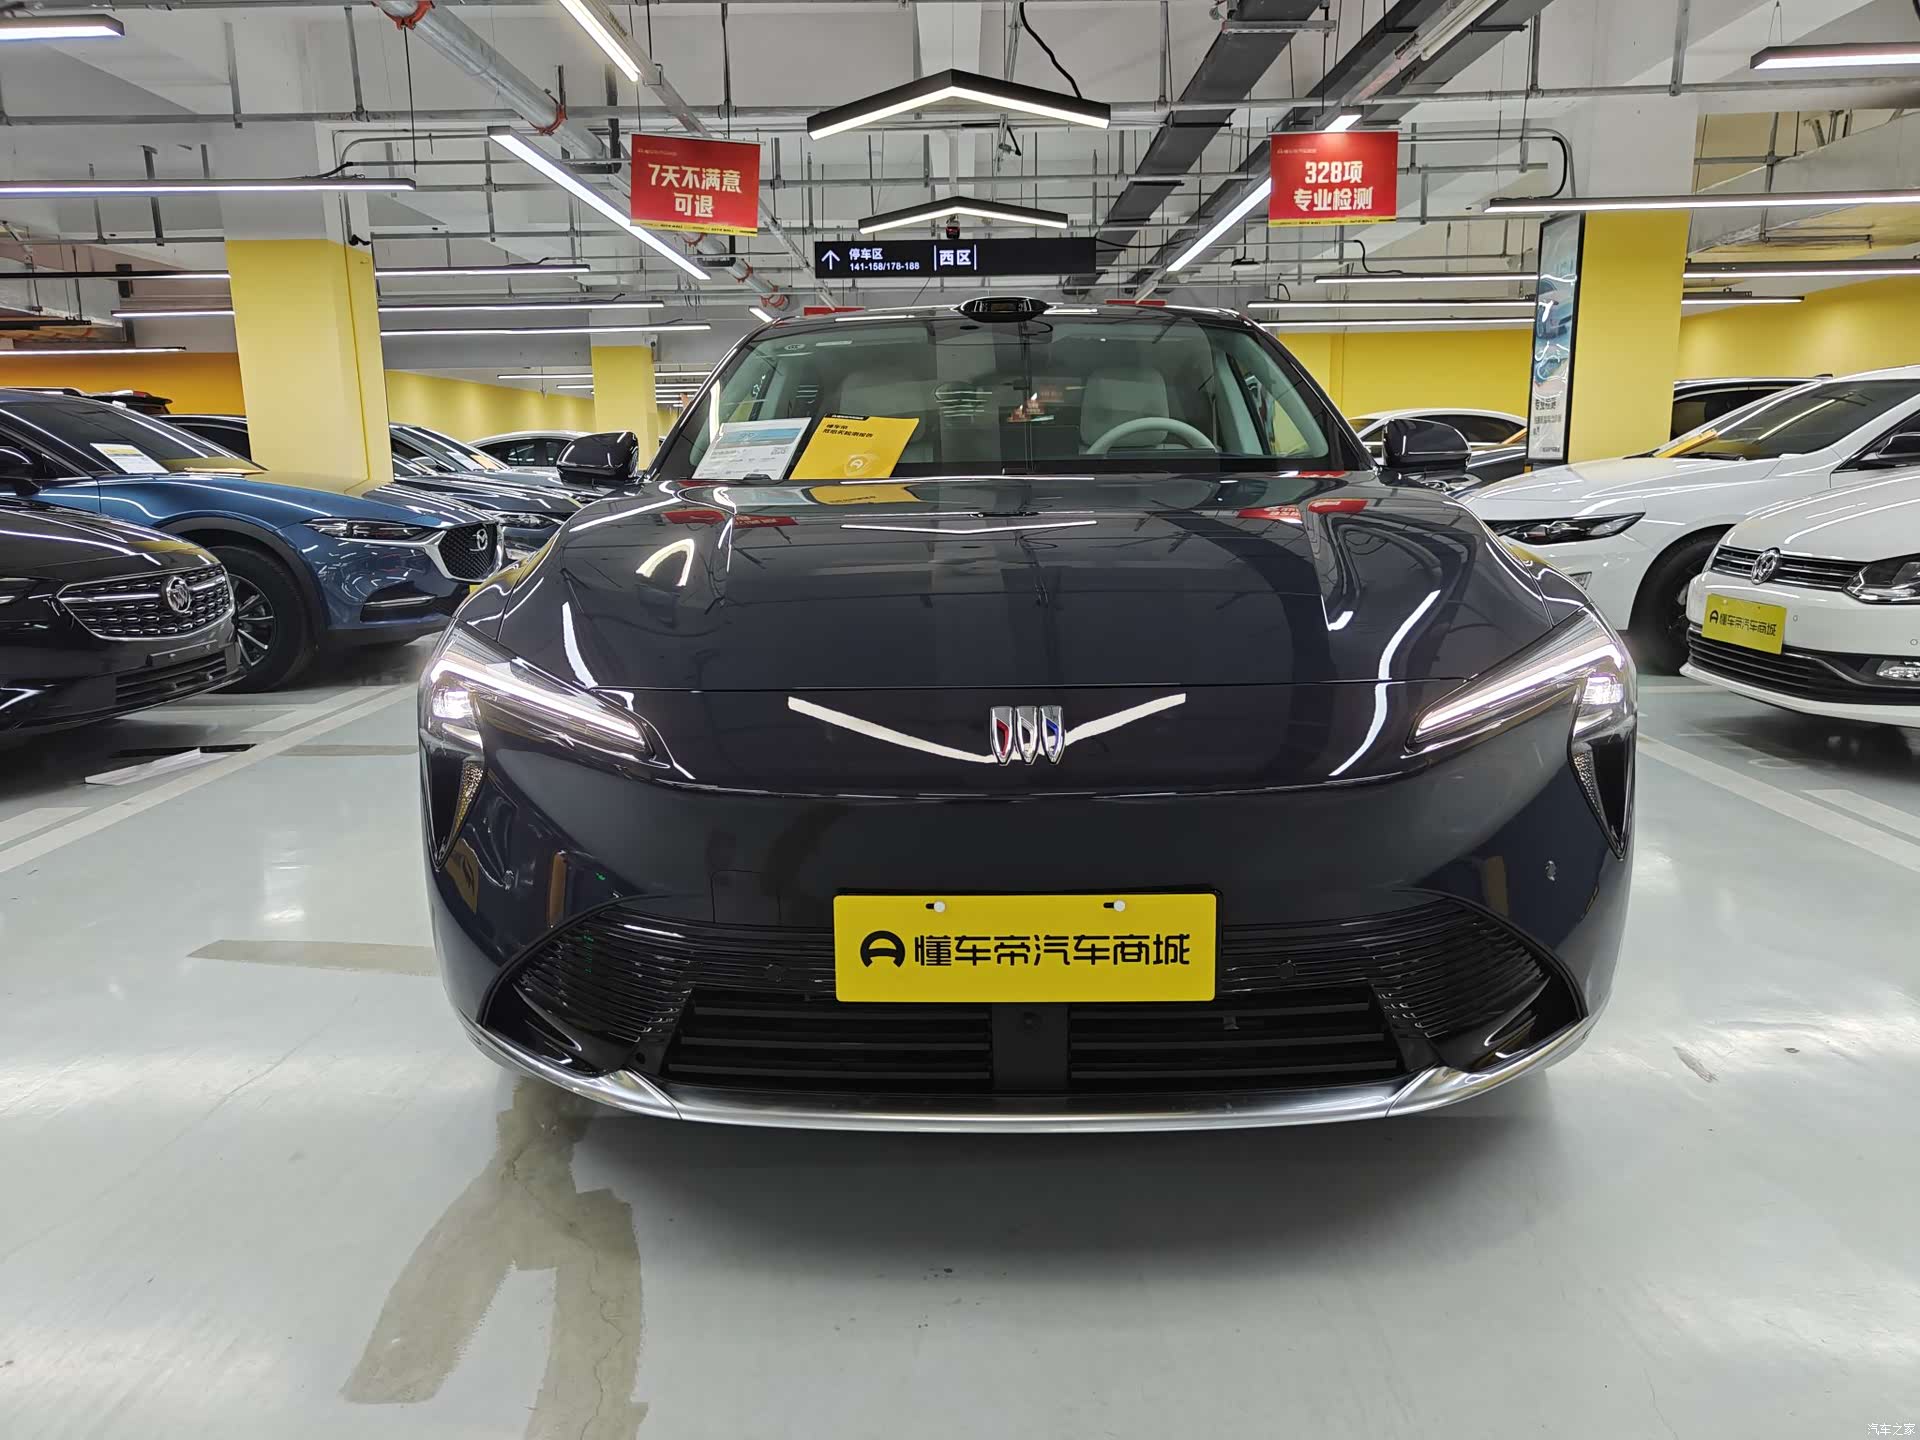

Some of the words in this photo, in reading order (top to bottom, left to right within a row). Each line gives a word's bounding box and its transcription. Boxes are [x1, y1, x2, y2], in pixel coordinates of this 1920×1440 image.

[648, 163, 743, 194] 7天不满意
[1305, 160, 1364, 184] 328项
[673, 192, 715, 218] 可退
[1293, 186, 1374, 212] 专业检测
[849, 247, 883, 260] 停车区
[939, 249, 972, 266] 西区
[914, 933, 1190, 967] 懂车帝汽车商城
